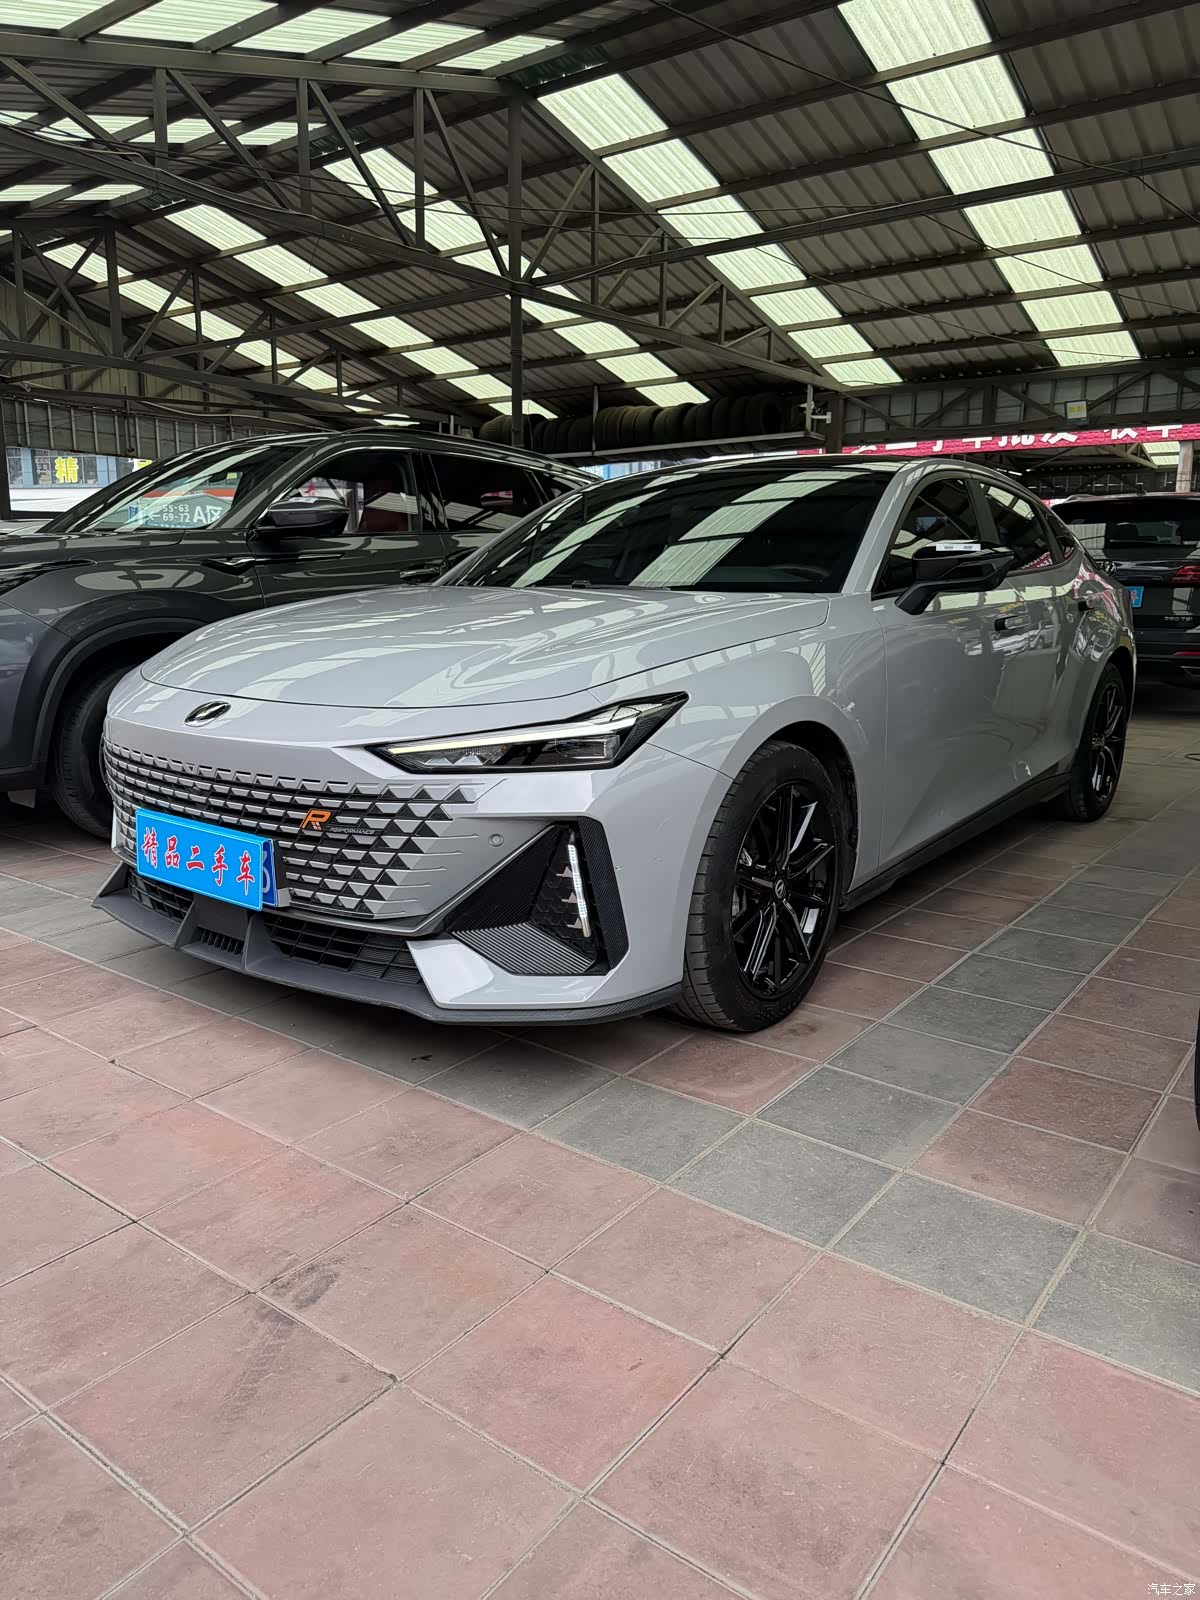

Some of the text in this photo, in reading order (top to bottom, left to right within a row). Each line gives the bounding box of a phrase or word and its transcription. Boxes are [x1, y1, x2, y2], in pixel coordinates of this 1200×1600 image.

[54, 456, 79, 484] 精
[162, 504, 190, 513] 55-63
[162, 513, 191, 523] 69-72
[300, 809, 332, 831] R
[141, 826, 256, 897] 精品二手车
